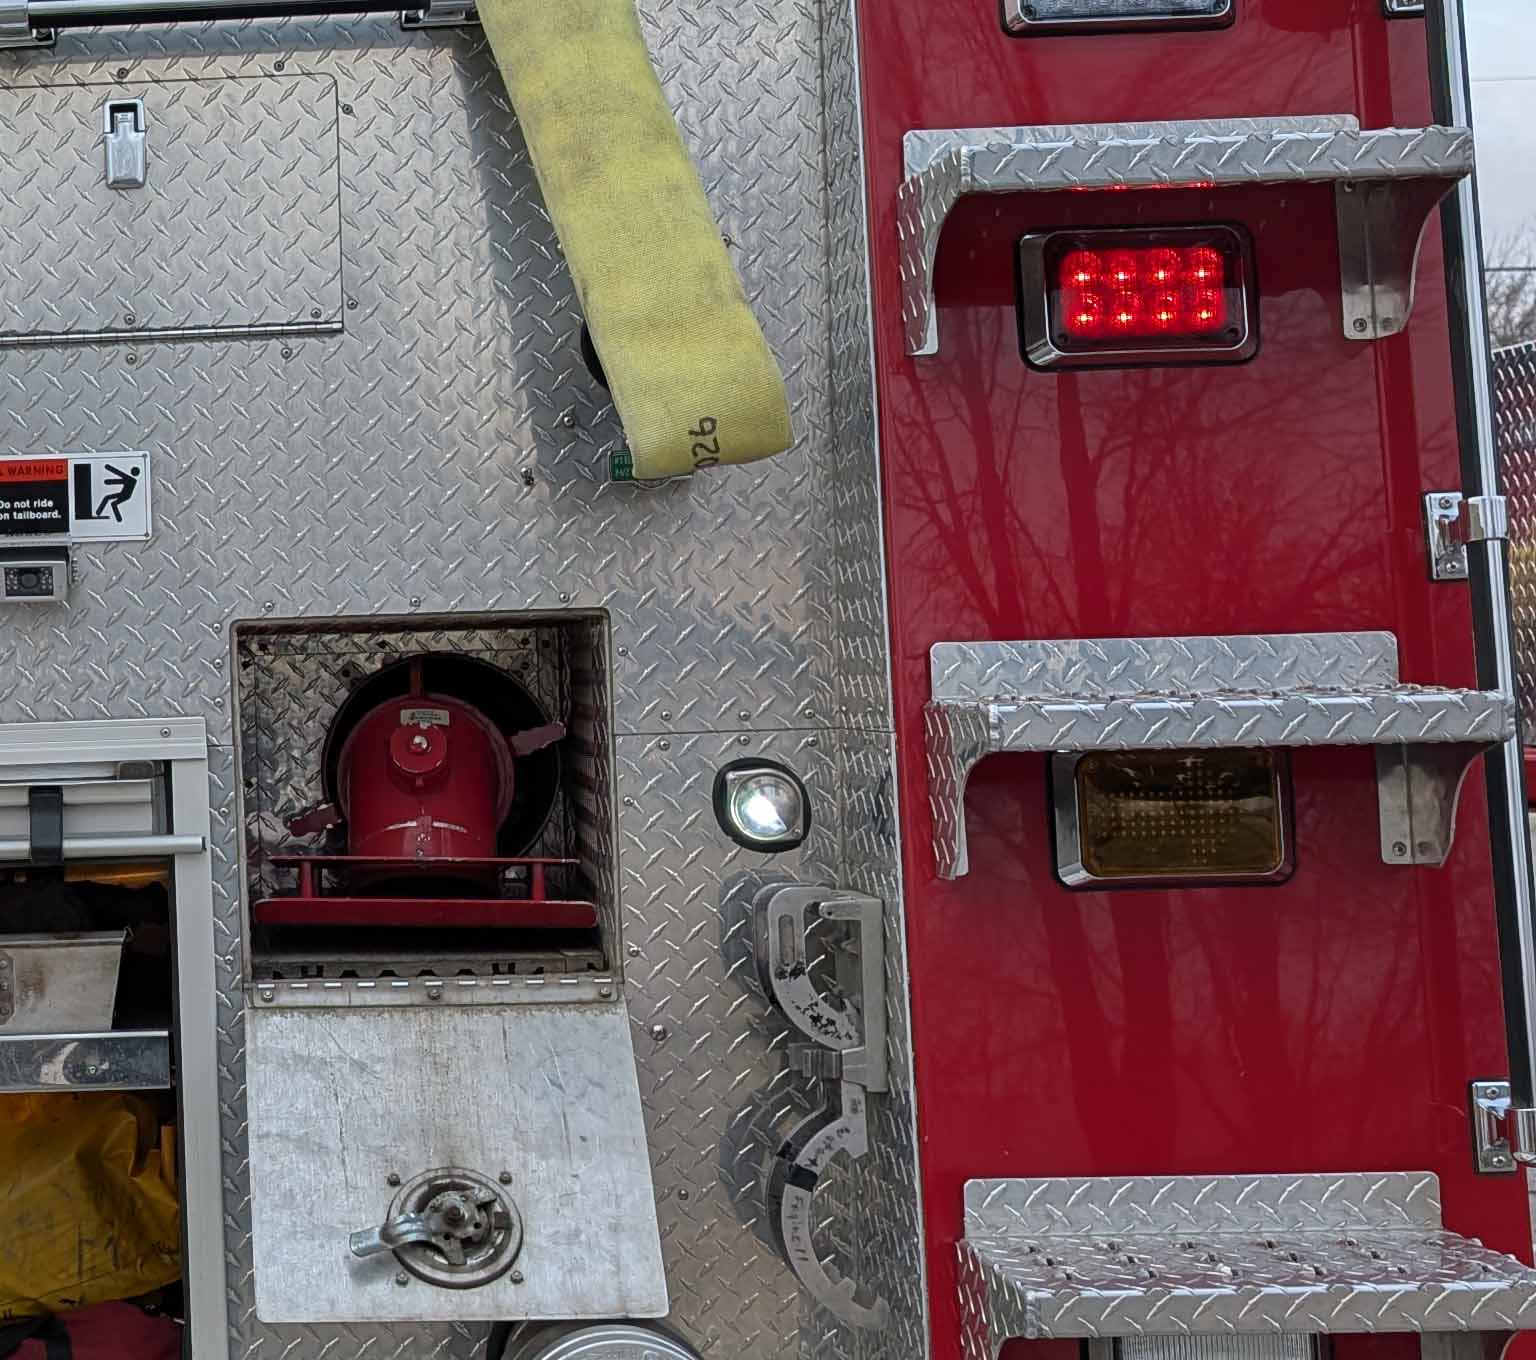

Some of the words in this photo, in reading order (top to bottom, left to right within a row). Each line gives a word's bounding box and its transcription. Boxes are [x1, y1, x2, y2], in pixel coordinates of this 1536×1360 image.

[7, 464, 65, 477] WARNING
[13, 499, 31, 509] not
[33, 498, 54, 508] ride
[13, 508, 62, 520] tailboard.
